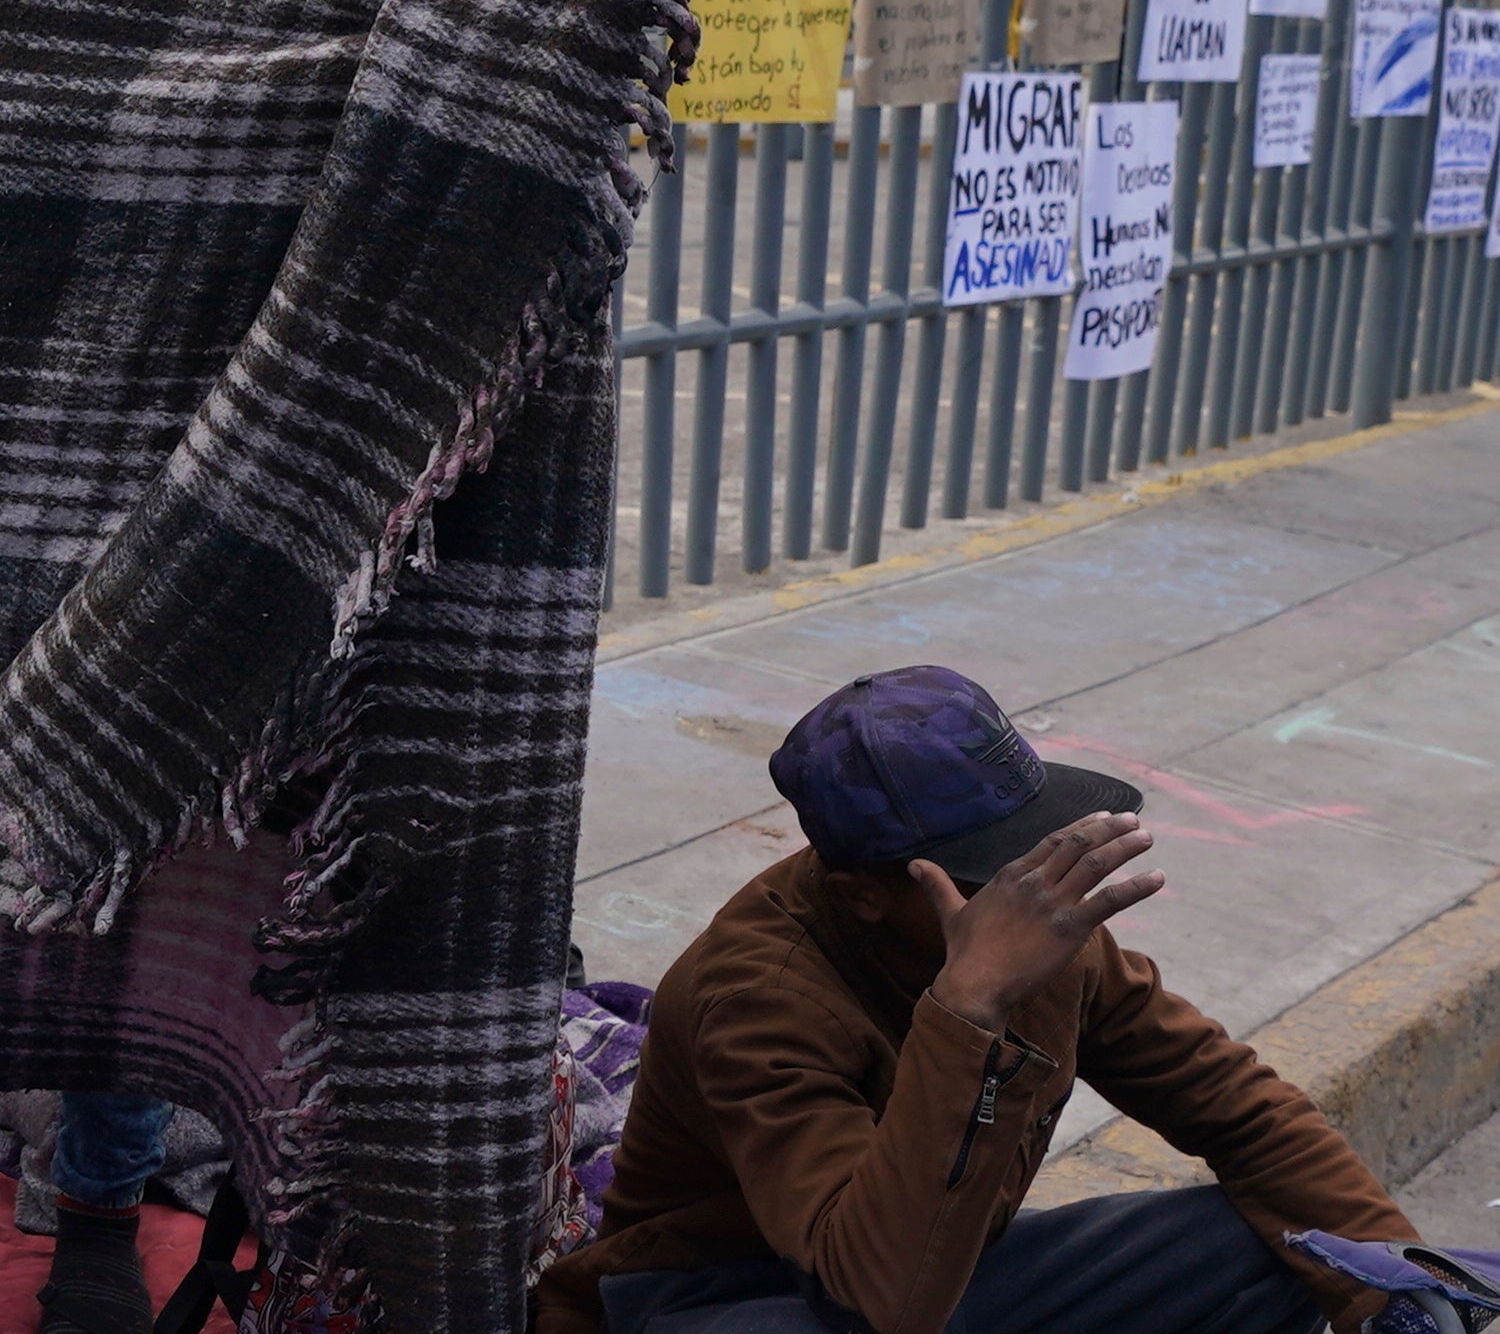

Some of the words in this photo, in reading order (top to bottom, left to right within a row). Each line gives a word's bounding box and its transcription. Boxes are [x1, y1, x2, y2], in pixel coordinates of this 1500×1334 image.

[683, 88, 772, 124] resguardo
[1098, 114, 1134, 150] Los
[954, 169, 987, 209] NO
[993, 164, 1017, 203] ES
[980, 208, 1032, 244] PARA
[1038, 200, 1067, 235] SER
